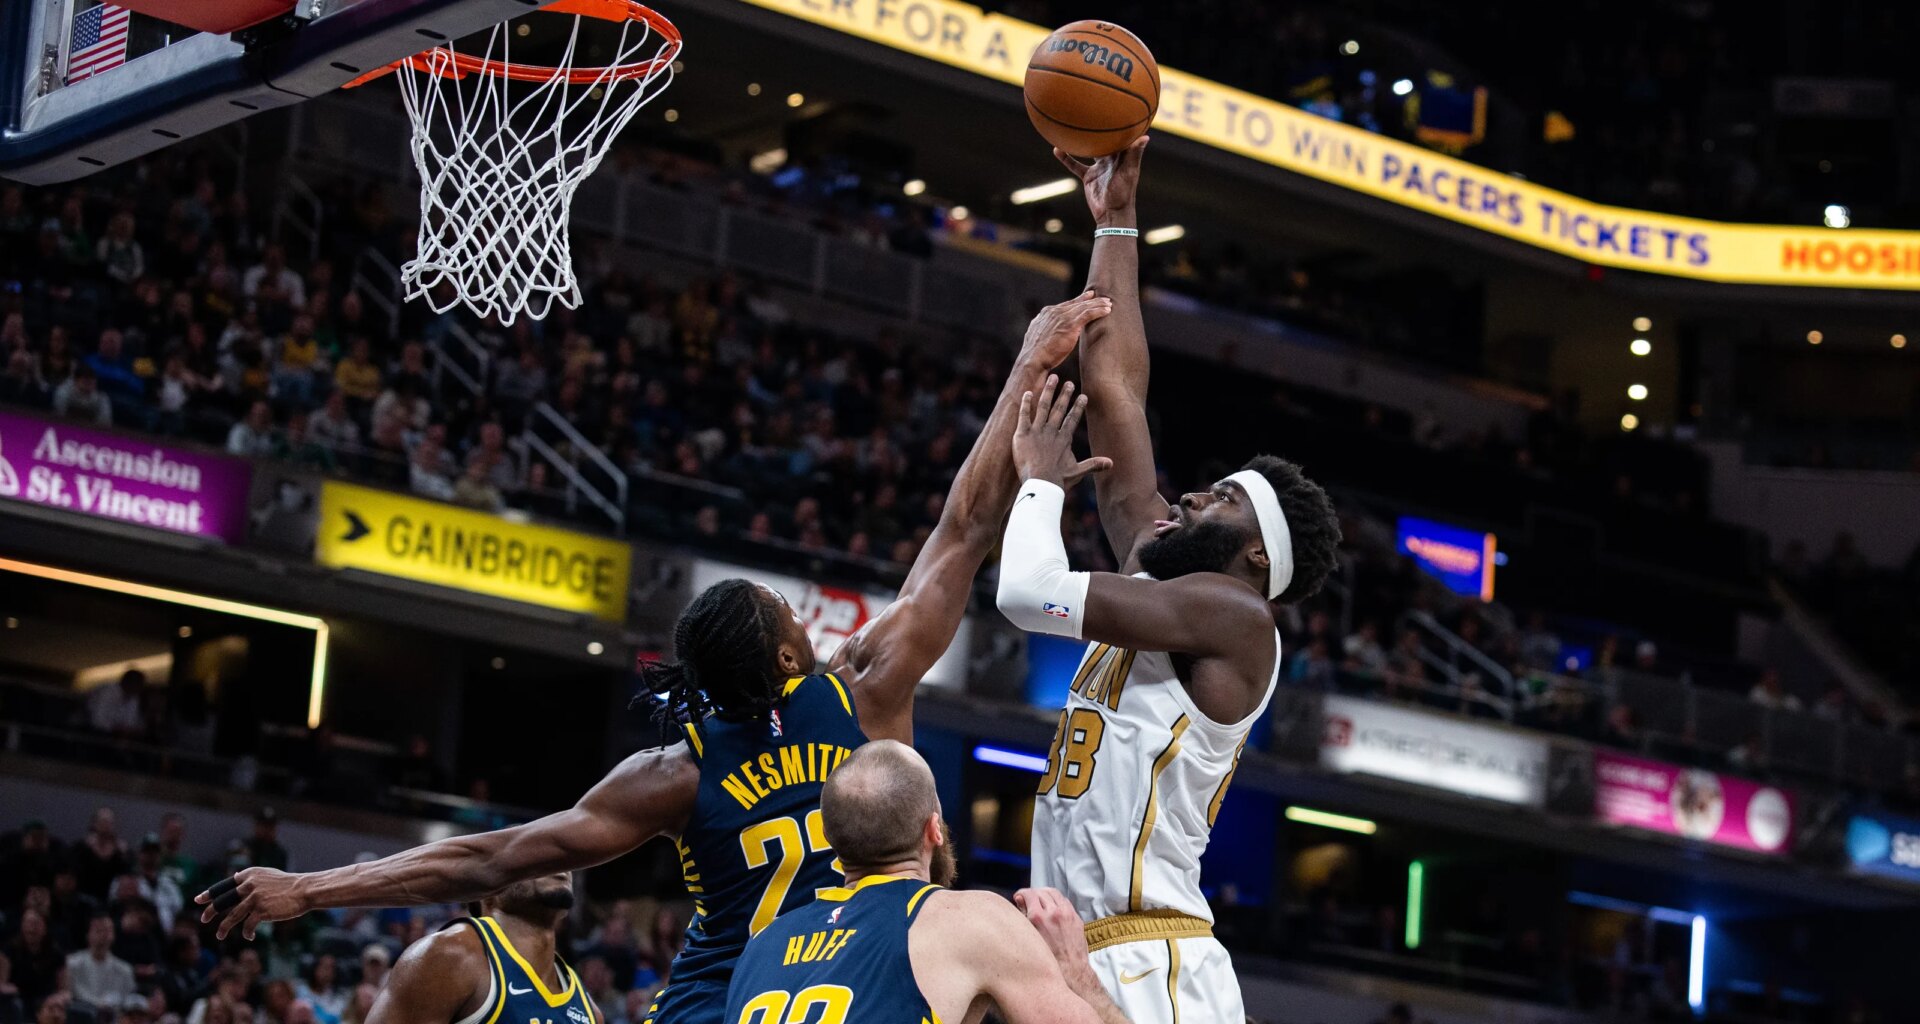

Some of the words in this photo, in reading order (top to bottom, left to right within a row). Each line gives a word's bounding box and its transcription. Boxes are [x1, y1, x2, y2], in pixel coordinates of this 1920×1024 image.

[1048, 38, 1134, 83] Wilson
[875, 0, 967, 52] FOR
[982, 30, 1012, 68] A
[1224, 99, 1275, 148] TO
[1286, 122, 1367, 176] WIN
[1381, 153, 1524, 226] PACERS
[1541, 202, 1711, 266] TICKETS
[1780, 239, 1920, 276] HOOSI
[32, 426, 202, 493] Ascension
[26, 465, 73, 508] St.
[74, 473, 204, 533] Vincent
[385, 515, 614, 600] GAINBRIDGE
[782, 928, 857, 967] HUFF
